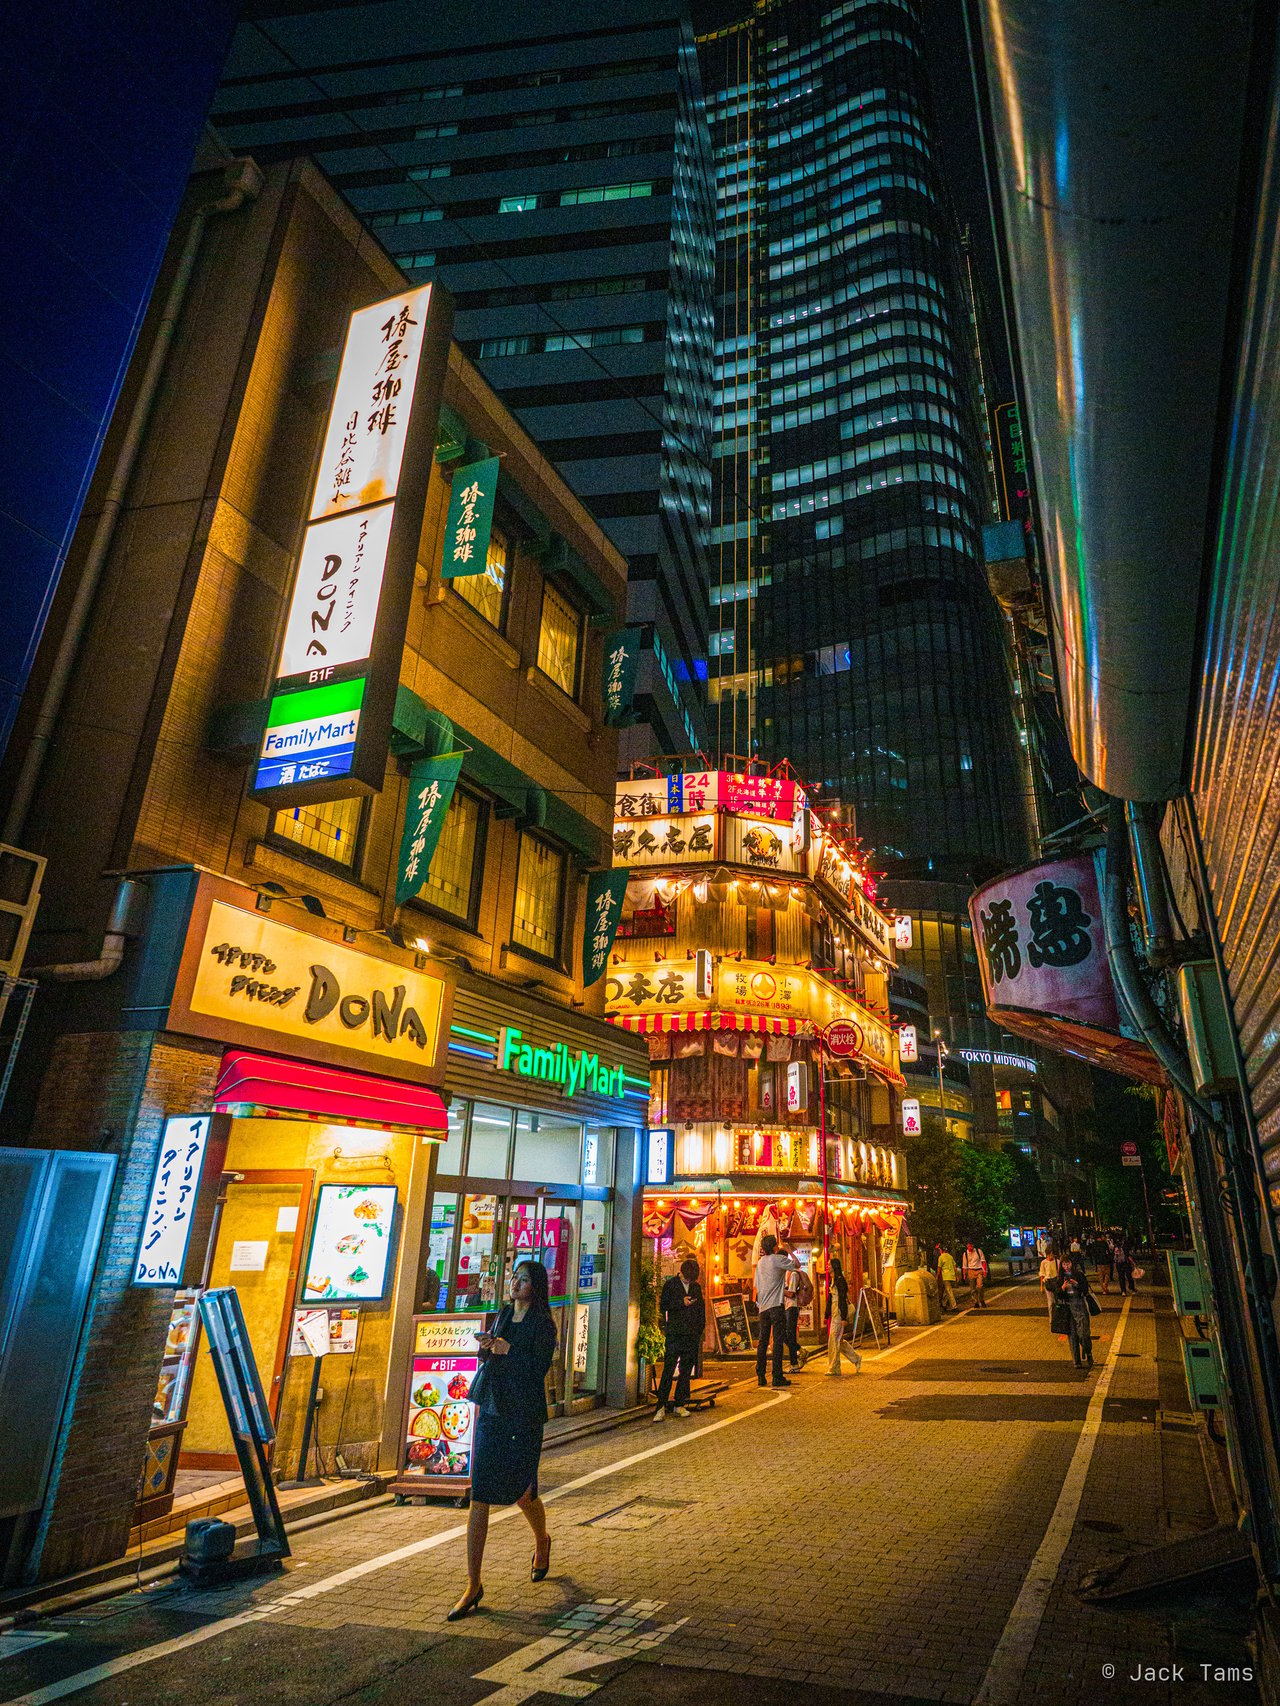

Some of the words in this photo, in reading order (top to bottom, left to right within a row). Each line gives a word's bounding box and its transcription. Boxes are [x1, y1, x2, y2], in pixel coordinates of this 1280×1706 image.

[367, 305, 418, 436] 椿屋珈琲
[453, 481, 485, 564] 椿屋珈琲
[306, 554, 343, 656] DONA
[308, 666, 335, 684] B1F
[265, 719, 356, 751] FamilyMart
[279, 765, 296, 785] 酒
[298, 760, 330, 780] たばこ
[727, 785, 737, 793] 2F
[404, 780, 442, 883] 椿屋珈琲
[591, 889, 617, 970] 椿屋珈琲
[304, 964, 428, 1050] DONA
[830, 1033, 855, 1046] 消火栓
[902, 1041, 915, 1057] 羊
[498, 1026, 625, 1098] FamilyMart
[960, 1050, 992, 1063] TOKYO
[993, 1053, 1026, 1069] MIDTOWN
[516, 1230, 555, 1246] ATM
[137, 1261, 178, 1280] DONA
[426, 1338, 468, 1348] イタリアワイン
[440, 1359, 457, 1371] B1F
